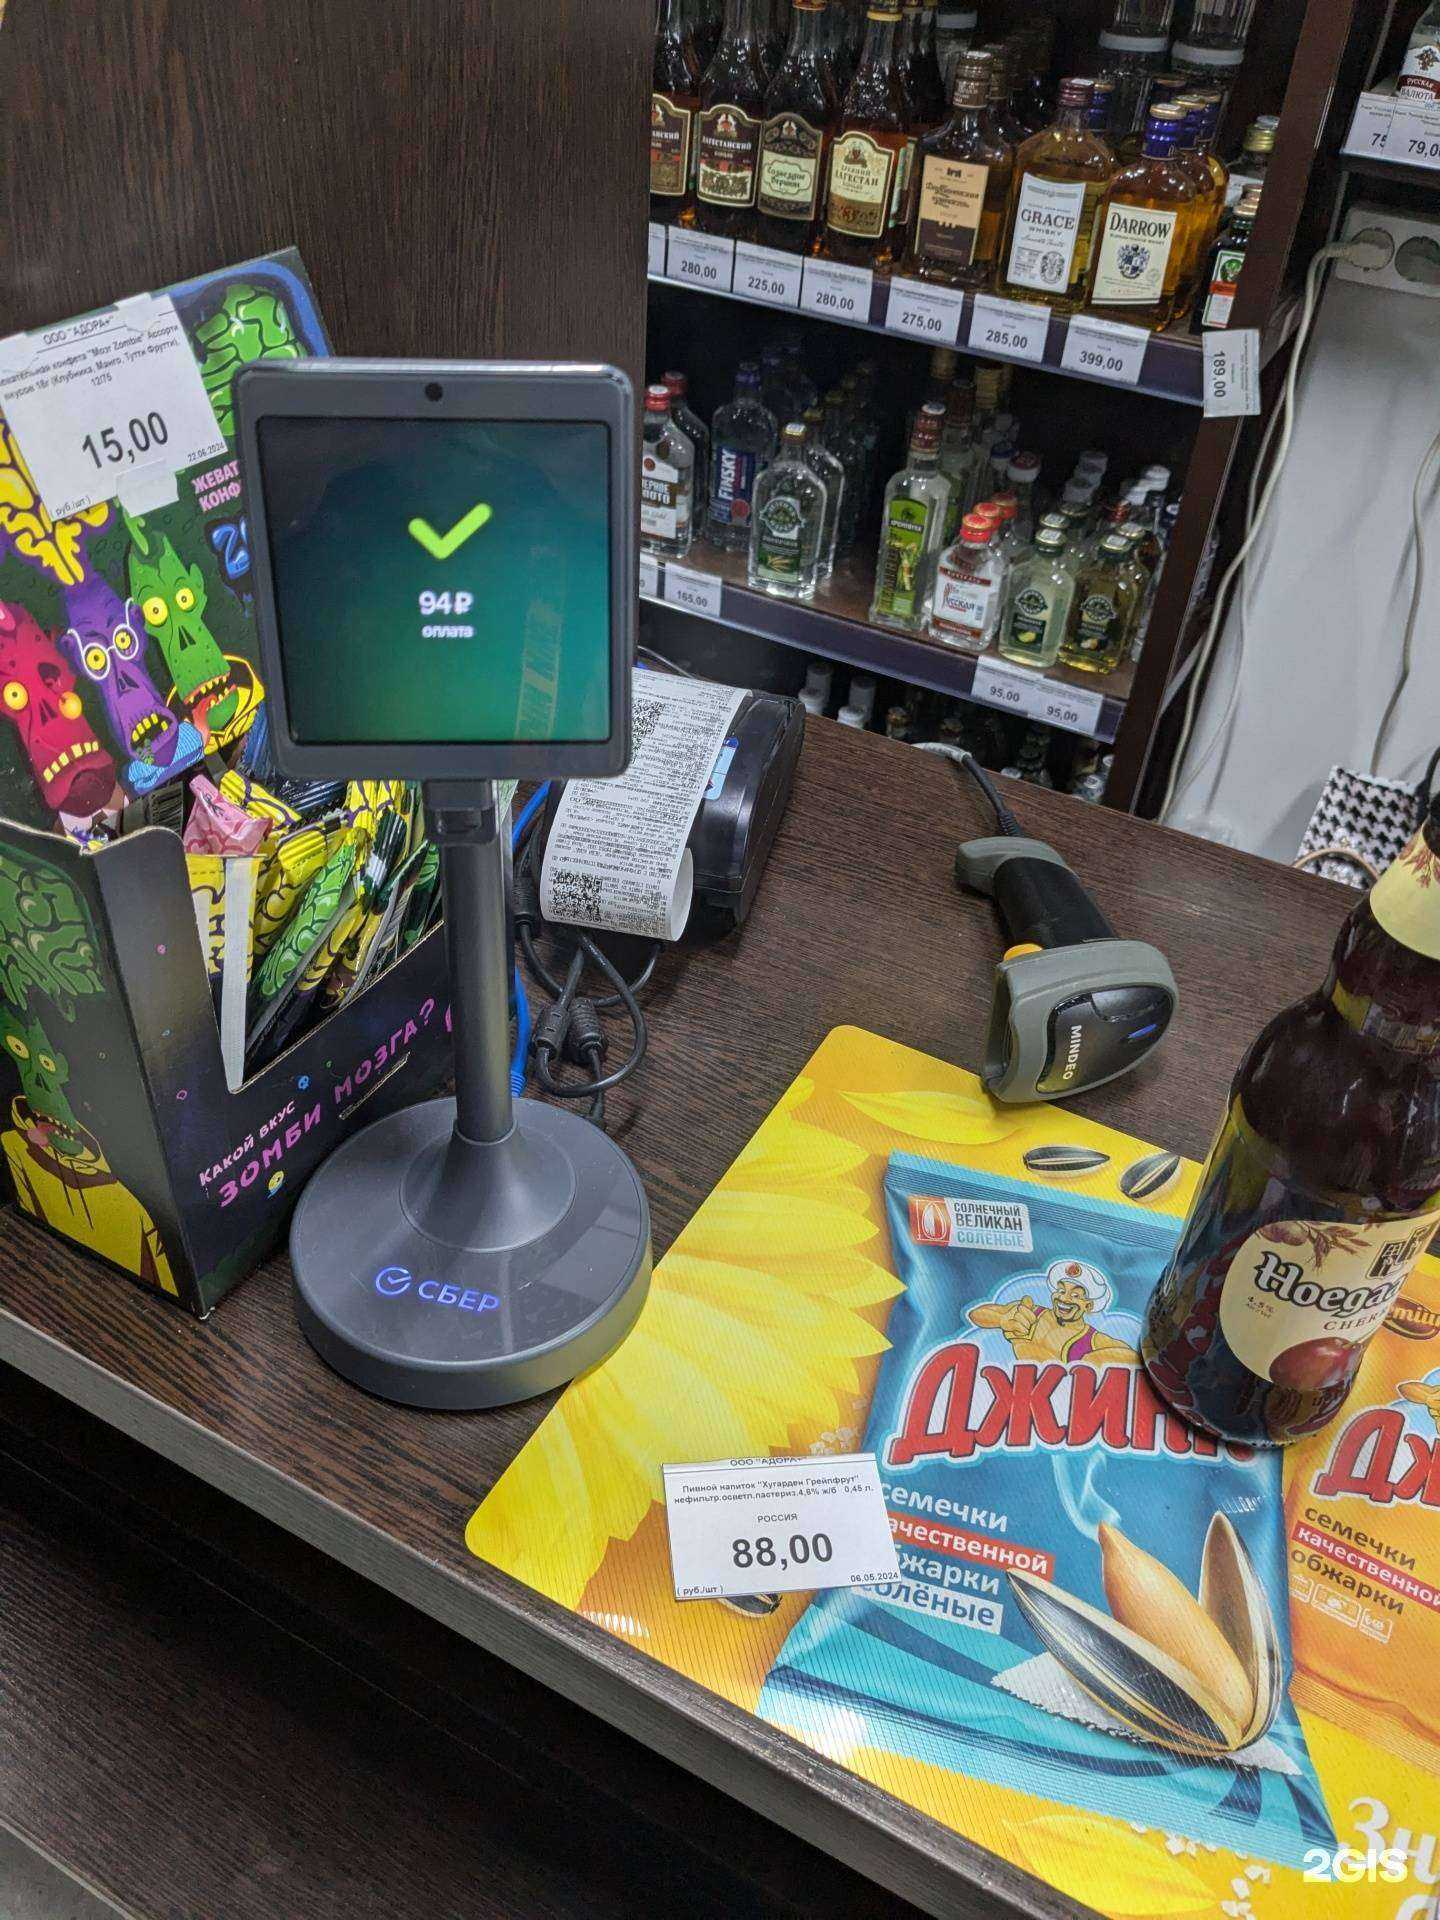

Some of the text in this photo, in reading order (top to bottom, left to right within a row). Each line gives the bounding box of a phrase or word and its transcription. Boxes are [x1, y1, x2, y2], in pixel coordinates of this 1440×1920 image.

[1408, 139, 1440, 158] 79,0
[1021, 209, 1075, 230] GRACE
[1109, 212, 1172, 239] DARROW
[1028, 226, 1062, 237] WHISKY
[680, 260, 717, 280] 280,00
[748, 276, 786, 296] 225,00
[816, 291, 855, 311] 280,00
[901, 311, 942, 332] 275,00
[985, 328, 1028, 350] 285,00
[1079, 349, 1123, 373] 399,00
[1213, 351, 1226, 398] 189,00
[82, 411, 169, 469] 15,00
[192, 460, 240, 494] ЖЕВАТ
[718, 448, 737, 499] FINSKY
[198, 480, 242, 513] КОНФ
[421, 624, 474, 639] оплата
[990, 686, 1020, 702] 95,00
[1046, 705, 1079, 723] 95,00
[1062, 1024, 1083, 1080] MINDEO
[217, 997, 436, 1208] ЗОМБИ МОЗГА?
[199, 1100, 296, 1187] КАКОЙ ВКУС
[953, 1200, 1022, 1218] СОЛНЕЧНЫЙ
[955, 1213, 1023, 1232] ВЕЛИКАН
[418, 1279, 501, 1312] СБЕР
[1323, 1312, 1380, 1331] CHER
[682, 1474, 860, 1494] Пивной напиток "Хугарден Грейпфрут"
[821, 1487, 837, 1495] ж/б
[844, 1485, 863, 1495] 0,45
[757, 1512, 799, 1523] РОССИЯ
[881, 1482, 1009, 1533] семечки
[887, 1515, 1048, 1575] ачественной
[1304, 1506, 1417, 1572] семечки
[732, 1532, 833, 1571] 88,00
[850, 1571, 899, 1583] 06.05.2024
[900, 1551, 1000, 1596] жарки
[1290, 1548, 1405, 1616] обжарки
[874, 1580, 996, 1627] олёные
